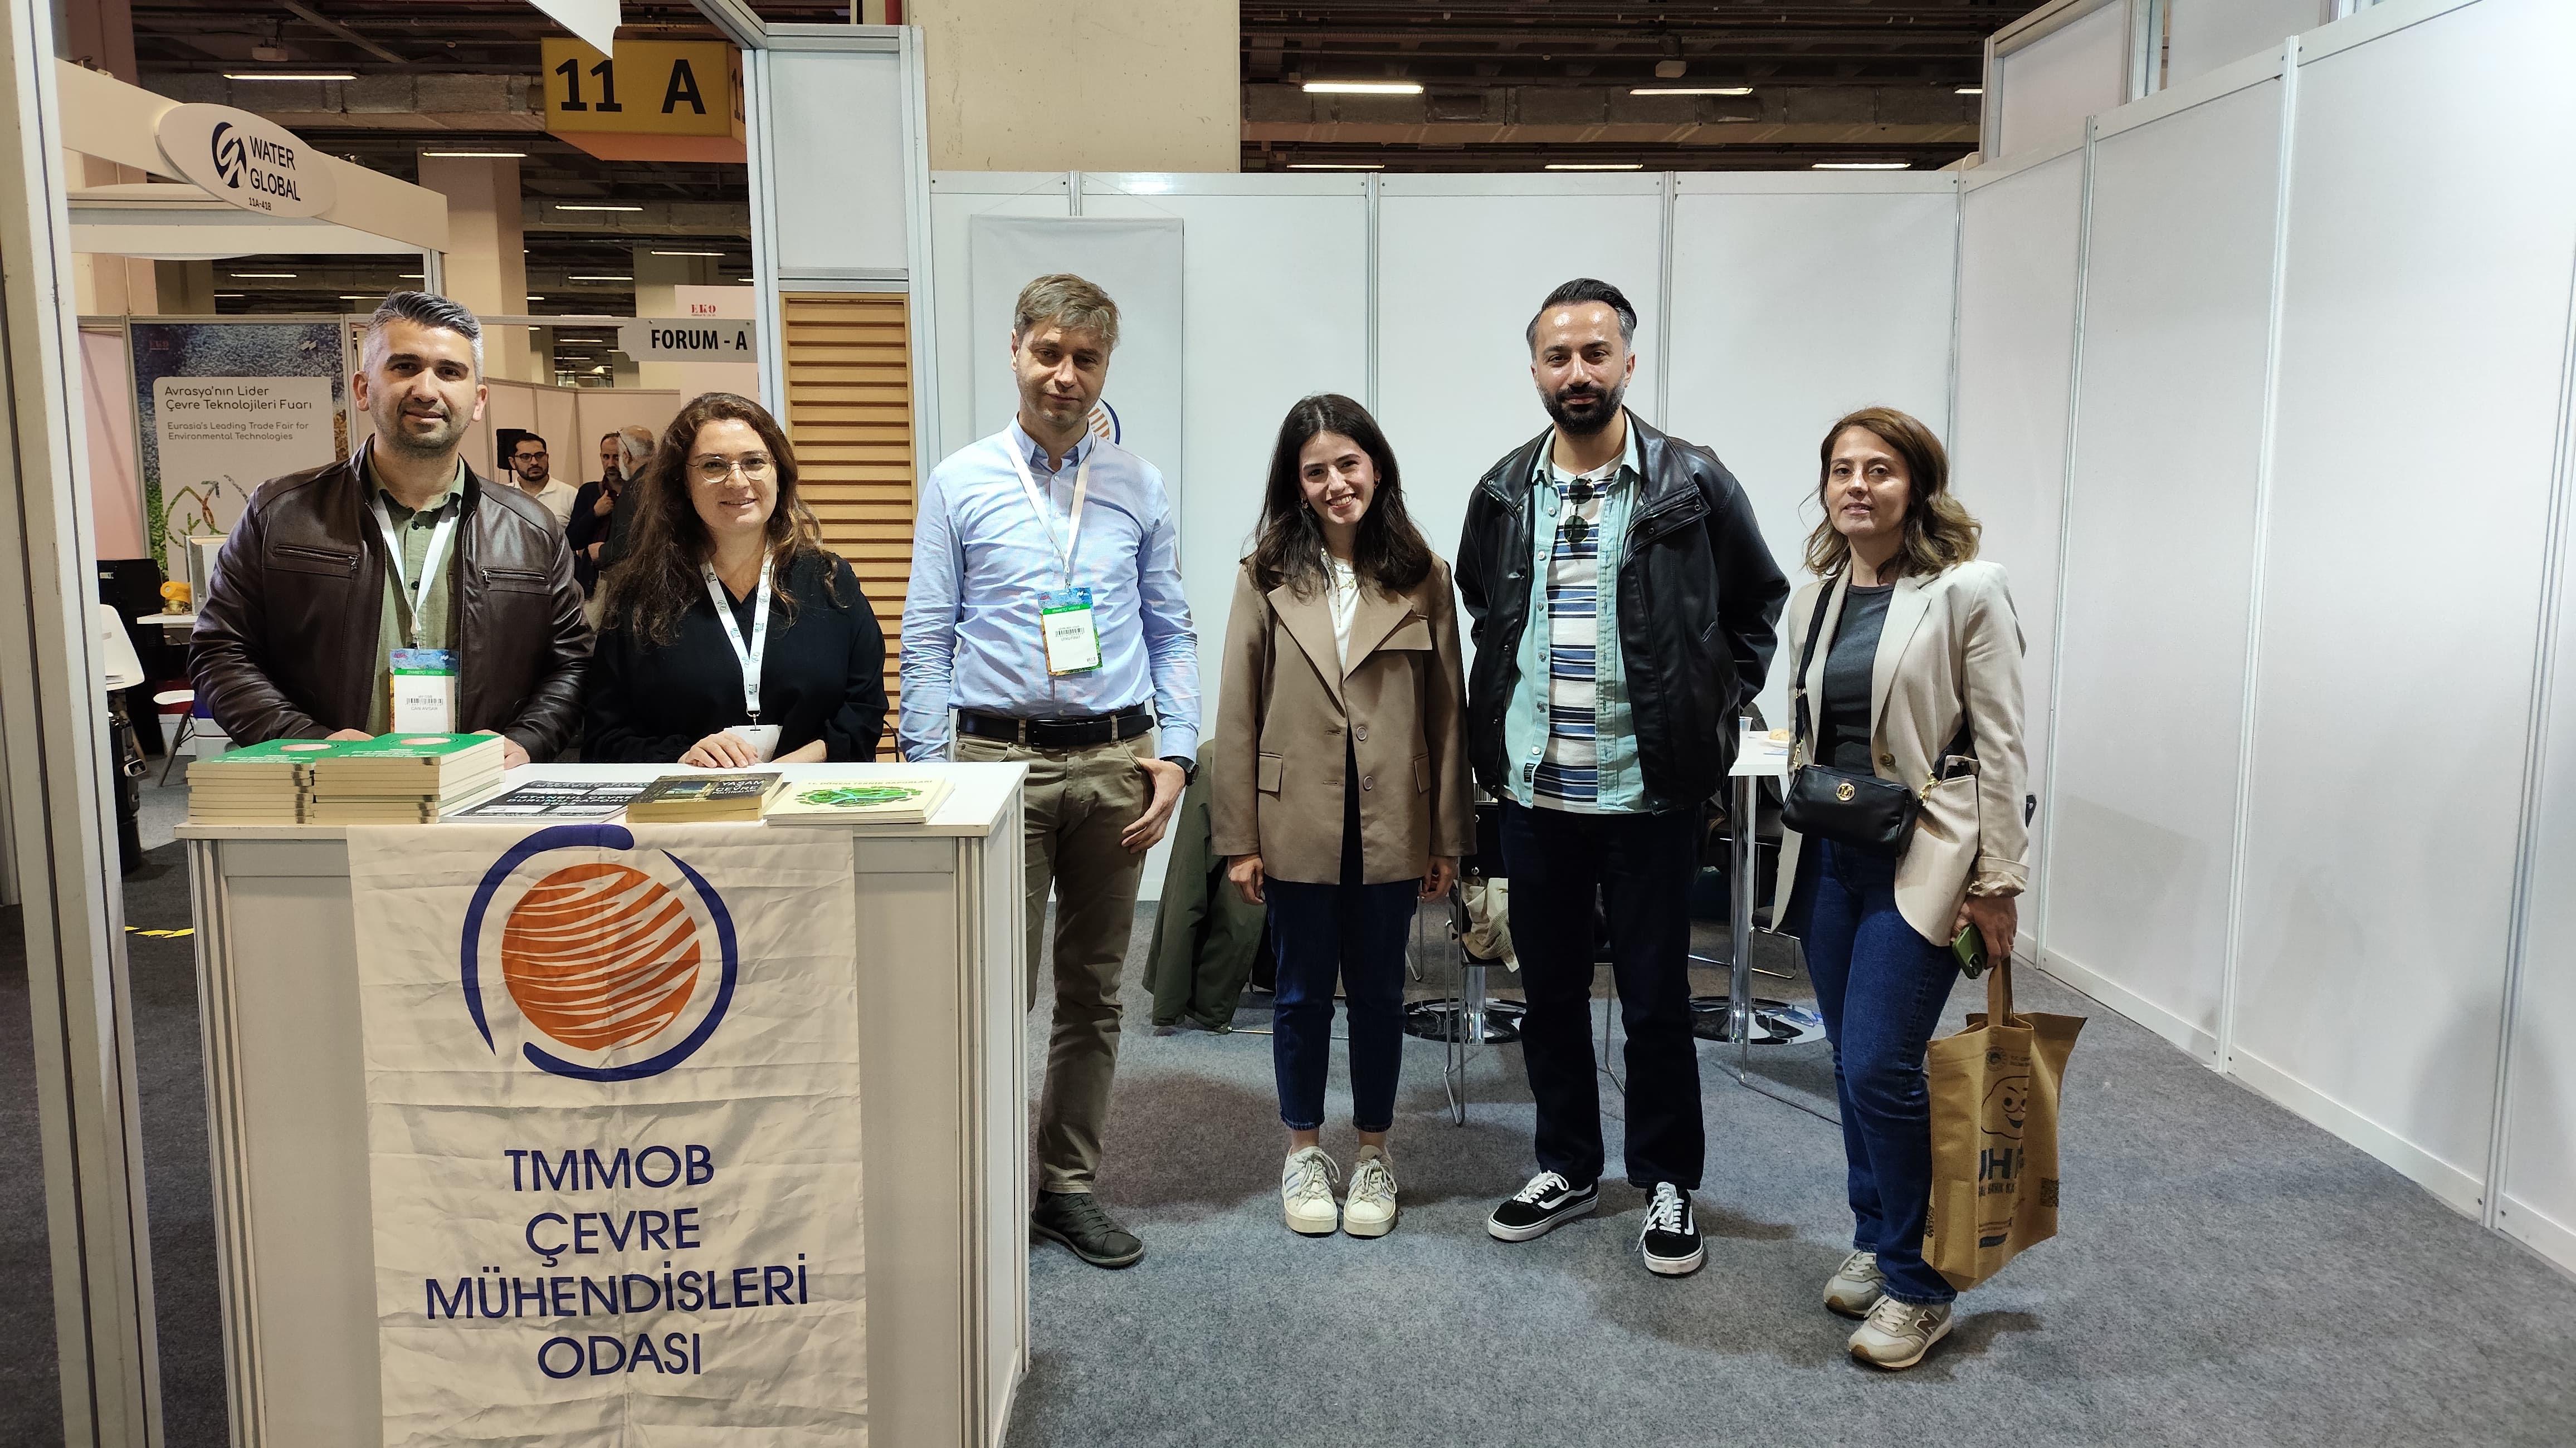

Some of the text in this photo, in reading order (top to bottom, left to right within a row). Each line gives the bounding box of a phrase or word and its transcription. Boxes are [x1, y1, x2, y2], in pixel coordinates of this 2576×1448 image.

[555, 58, 707, 115] 11 A
[249, 135, 296, 170] WATER
[250, 168, 301, 202] GLOBAL
[248, 197, 272, 211] 11A-418
[691, 304, 716, 314] EKO
[651, 329, 719, 350] FORUM
[735, 331, 748, 350] A
[165, 386, 269, 398] Avrasya'nın Lider
[166, 399, 312, 412] Çevre Teknolojileri Fuarı
[210, 422, 246, 431] Leading
[235, 432, 293, 442] Technologies
[504, 1144, 715, 1192] TMMOB
[525, 1207, 701, 1268] ÇEVRE
[426, 1253, 808, 1320] MÜHENDİSLERİ
[538, 1332, 701, 1379] ODASI
